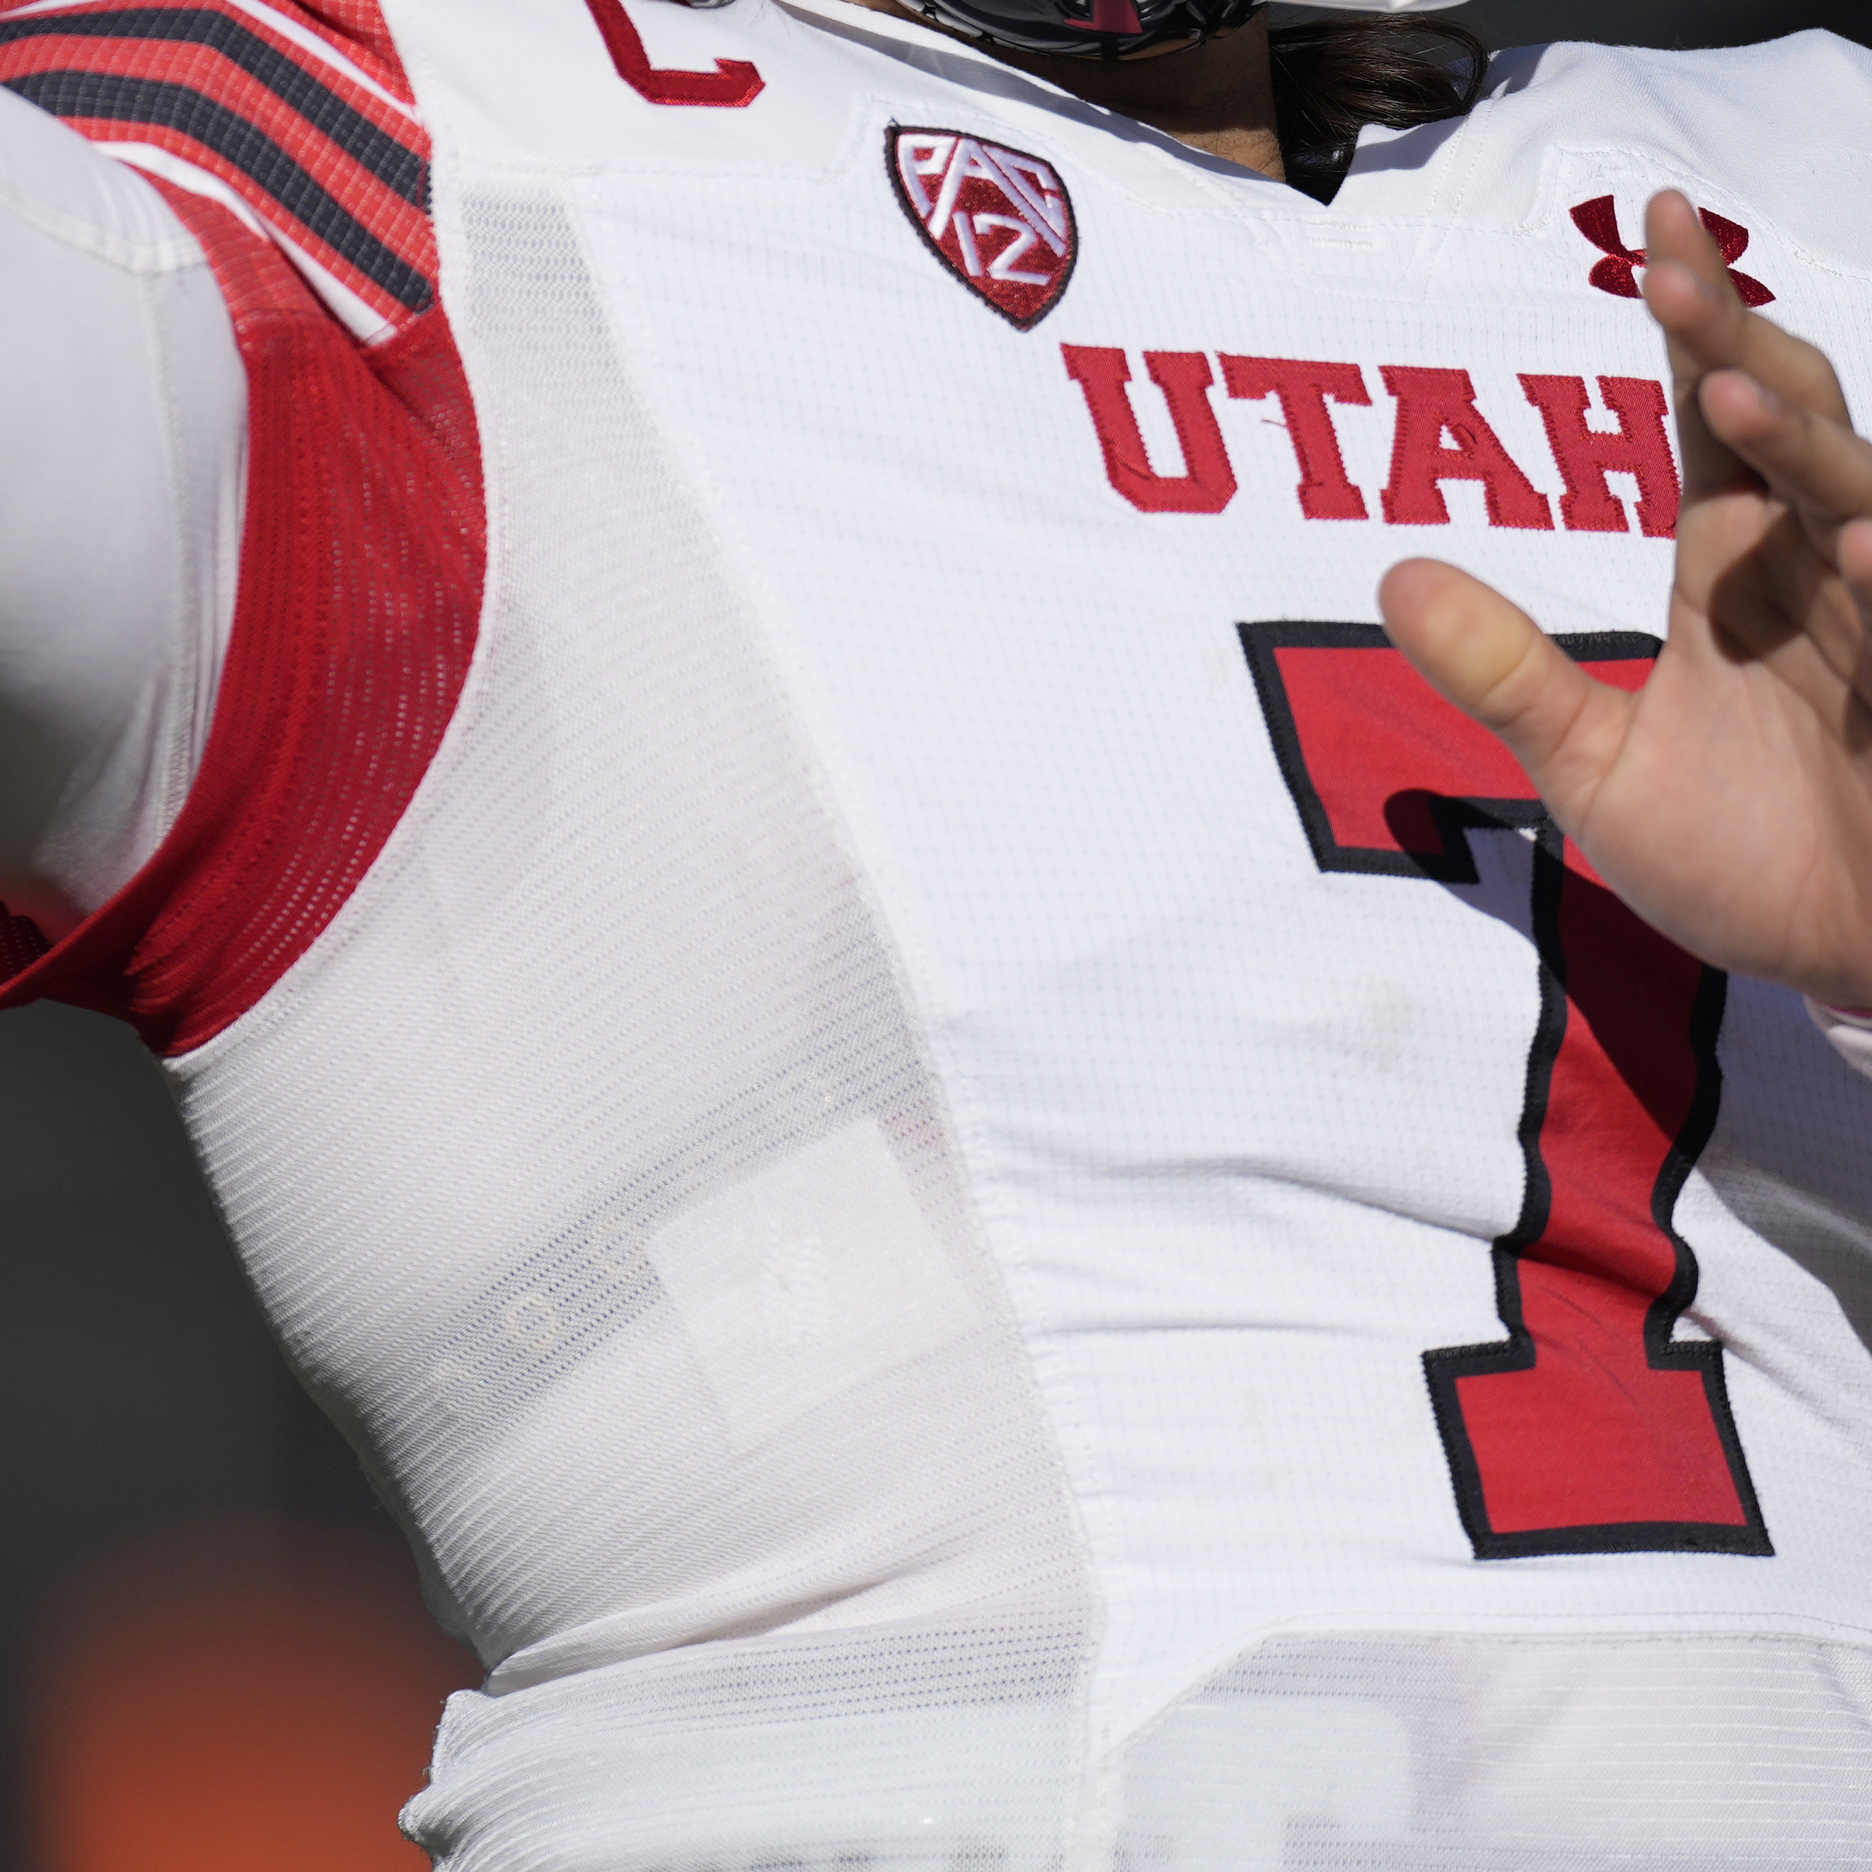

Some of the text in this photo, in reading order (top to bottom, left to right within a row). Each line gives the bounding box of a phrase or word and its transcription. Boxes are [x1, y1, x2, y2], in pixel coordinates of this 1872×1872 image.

[897, 133, 1068, 258] PAC
[952, 210, 1053, 286] 12
[1060, 342, 1683, 539] UTAH
[1237, 621, 1776, 1559] 7
